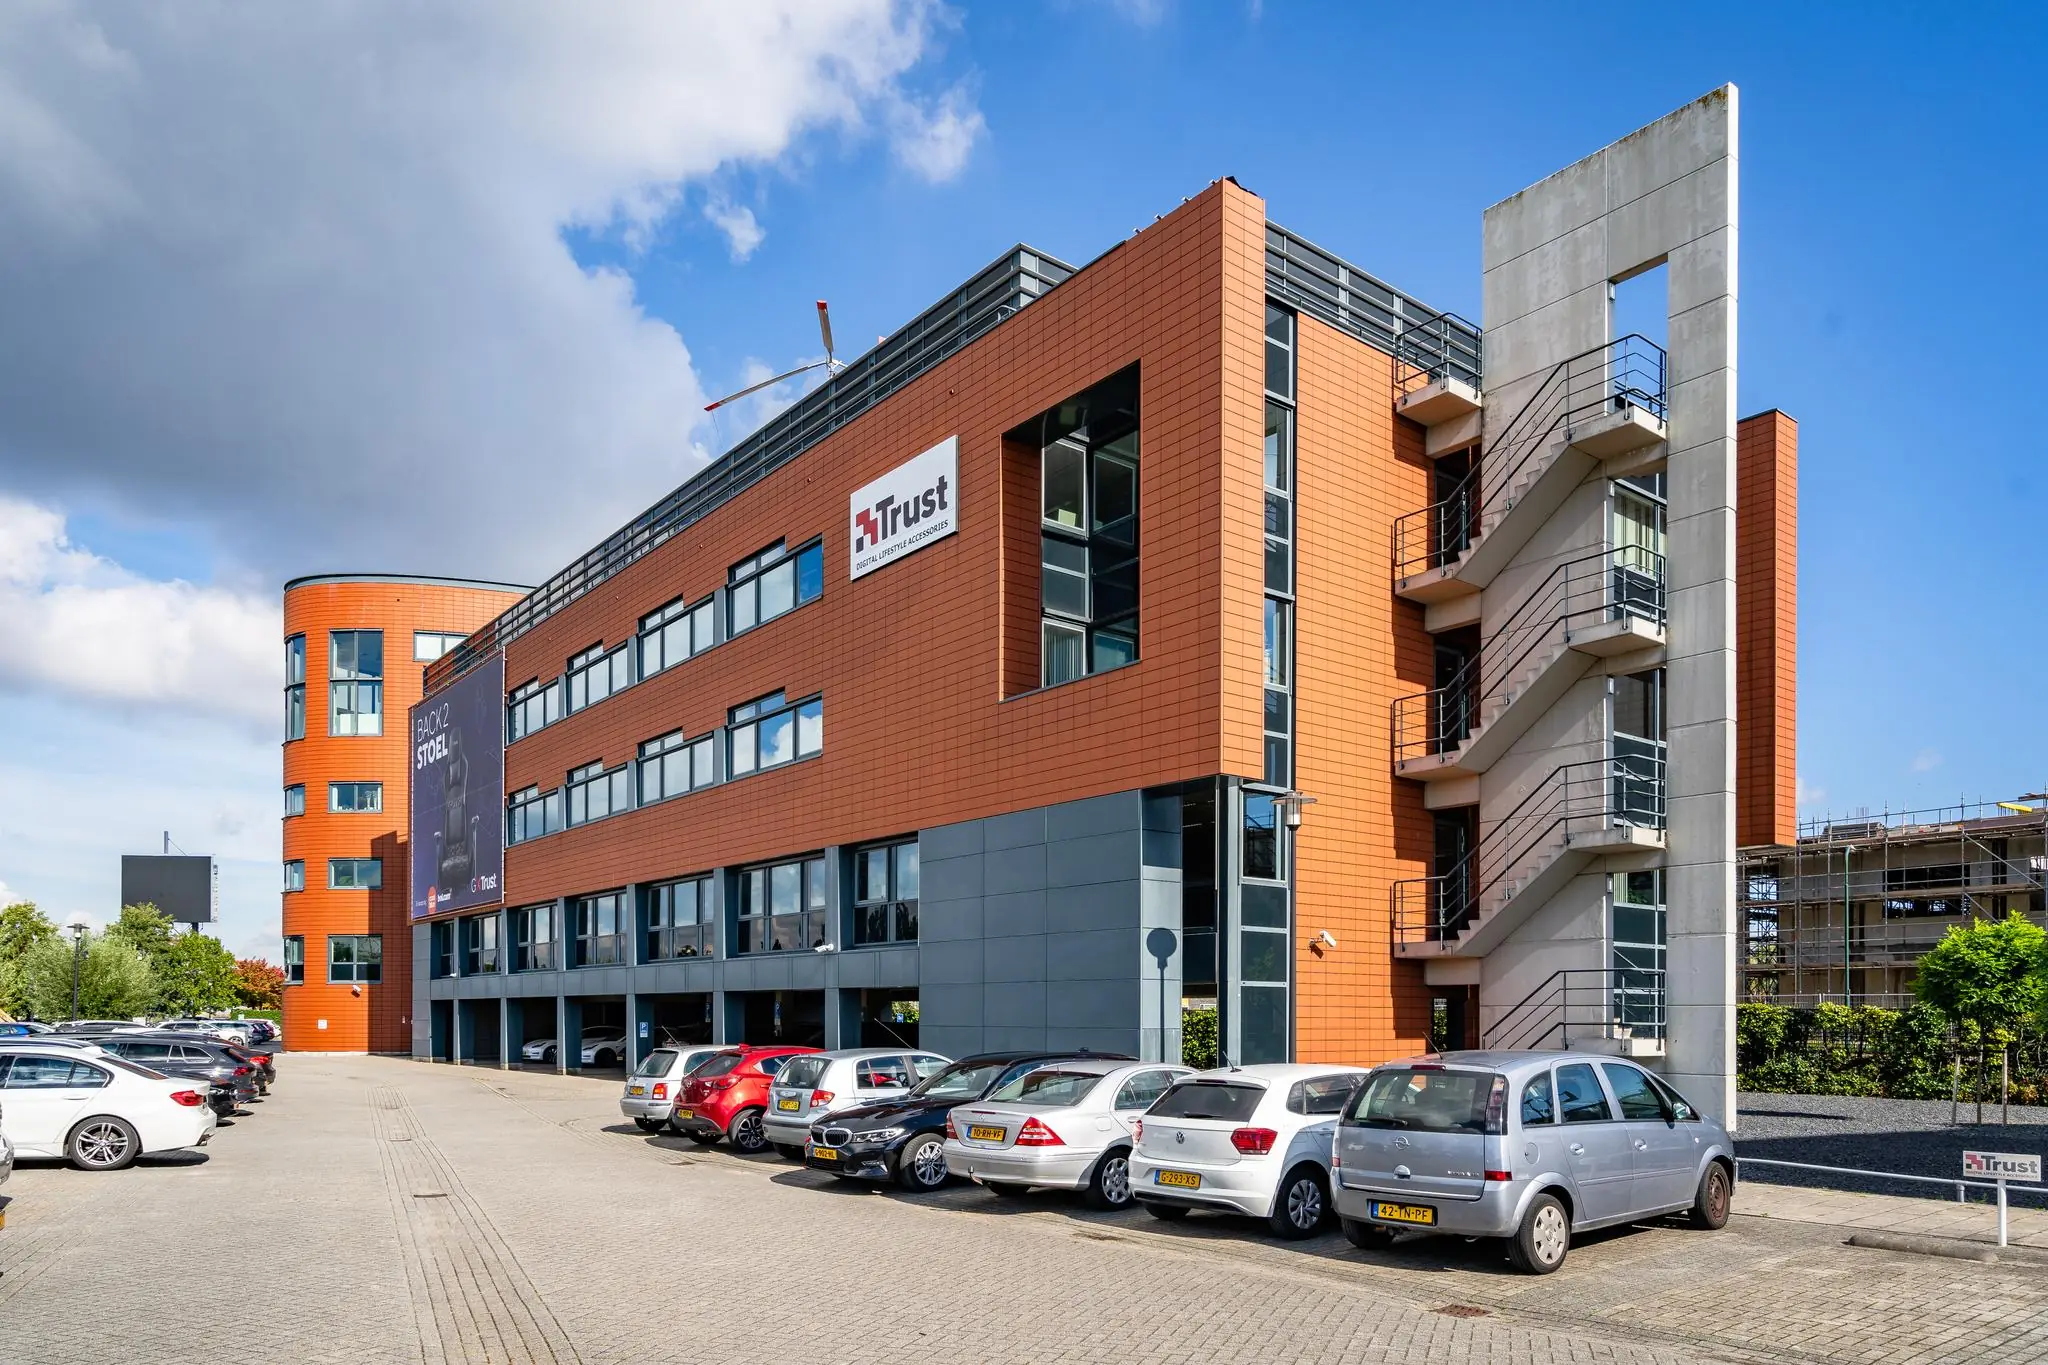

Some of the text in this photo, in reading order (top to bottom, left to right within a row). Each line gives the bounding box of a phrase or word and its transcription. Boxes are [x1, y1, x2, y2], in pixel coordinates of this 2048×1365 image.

[875, 474, 948, 541] Trust
[856, 519, 949, 571] DIGITAL LIFESTYLE ACCESSORIES
[417, 733, 449, 770] STOEL
[1161, 1172, 1196, 1185] G-293-XS
[1980, 1155, 2038, 1174] Trust
